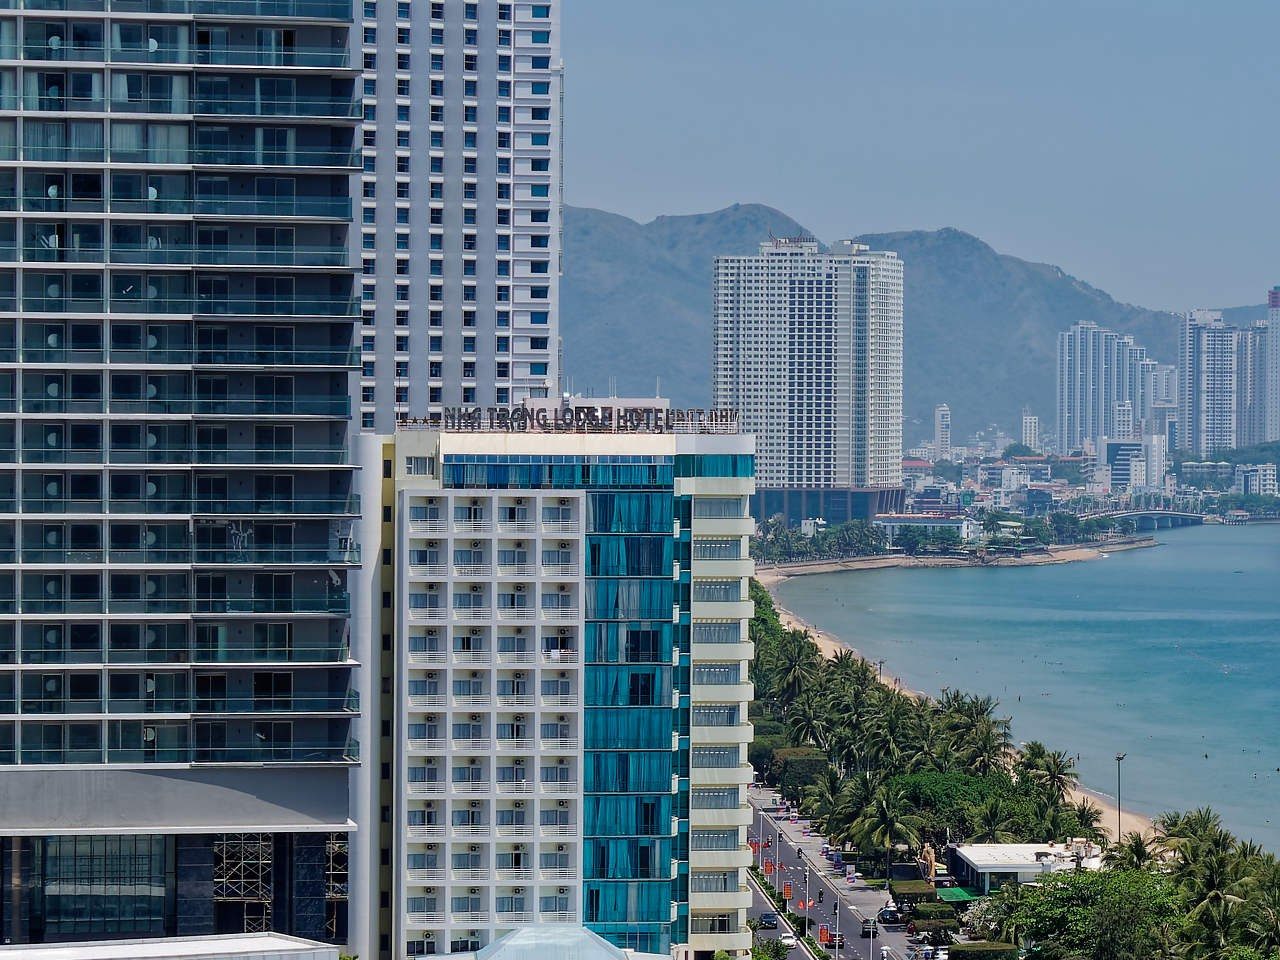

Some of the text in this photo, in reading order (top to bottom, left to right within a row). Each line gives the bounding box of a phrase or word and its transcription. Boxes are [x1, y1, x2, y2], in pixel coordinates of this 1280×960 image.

[487, 407, 548, 431] TRANG
[554, 407, 613, 431] LODGE
[616, 407, 674, 431] HOTEL
